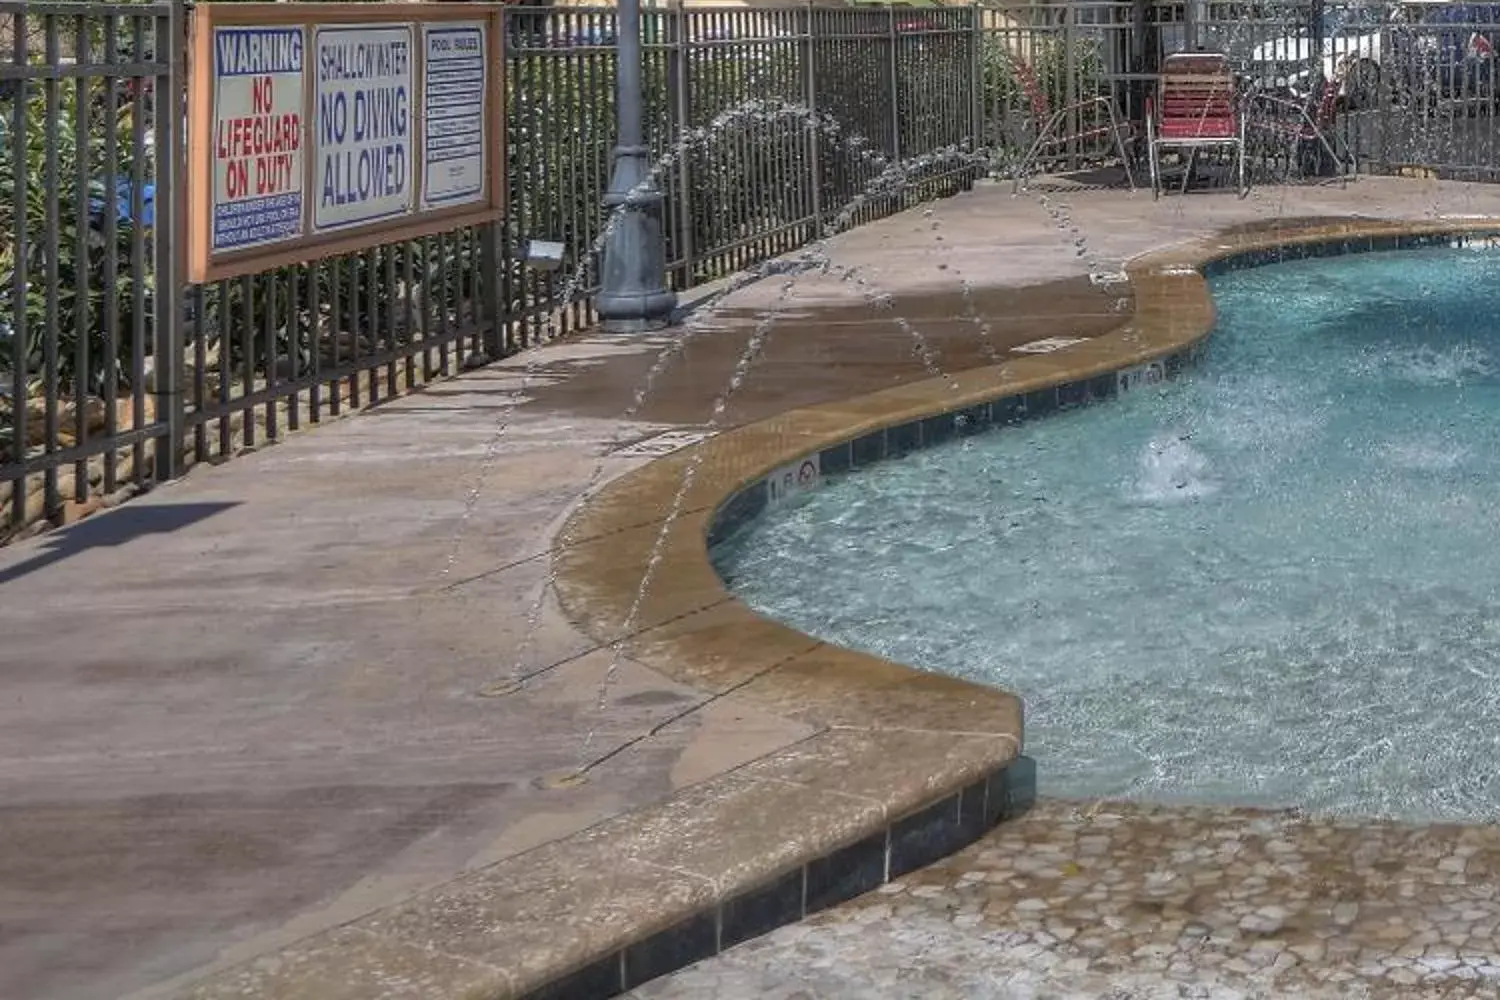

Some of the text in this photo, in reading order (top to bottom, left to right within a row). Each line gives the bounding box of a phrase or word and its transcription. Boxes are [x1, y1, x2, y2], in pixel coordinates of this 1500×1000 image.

[218, 31, 302, 73] WARNING
[321, 41, 407, 81] SHALLOW WATER
[431, 39, 452, 51] POOL
[253, 76, 273, 114] NO
[321, 86, 407, 147] NO DIVING
[218, 113, 300, 158] LIFEGUARD
[227, 153, 293, 198] ON DUTY
[322, 143, 405, 208] ALLOWED
